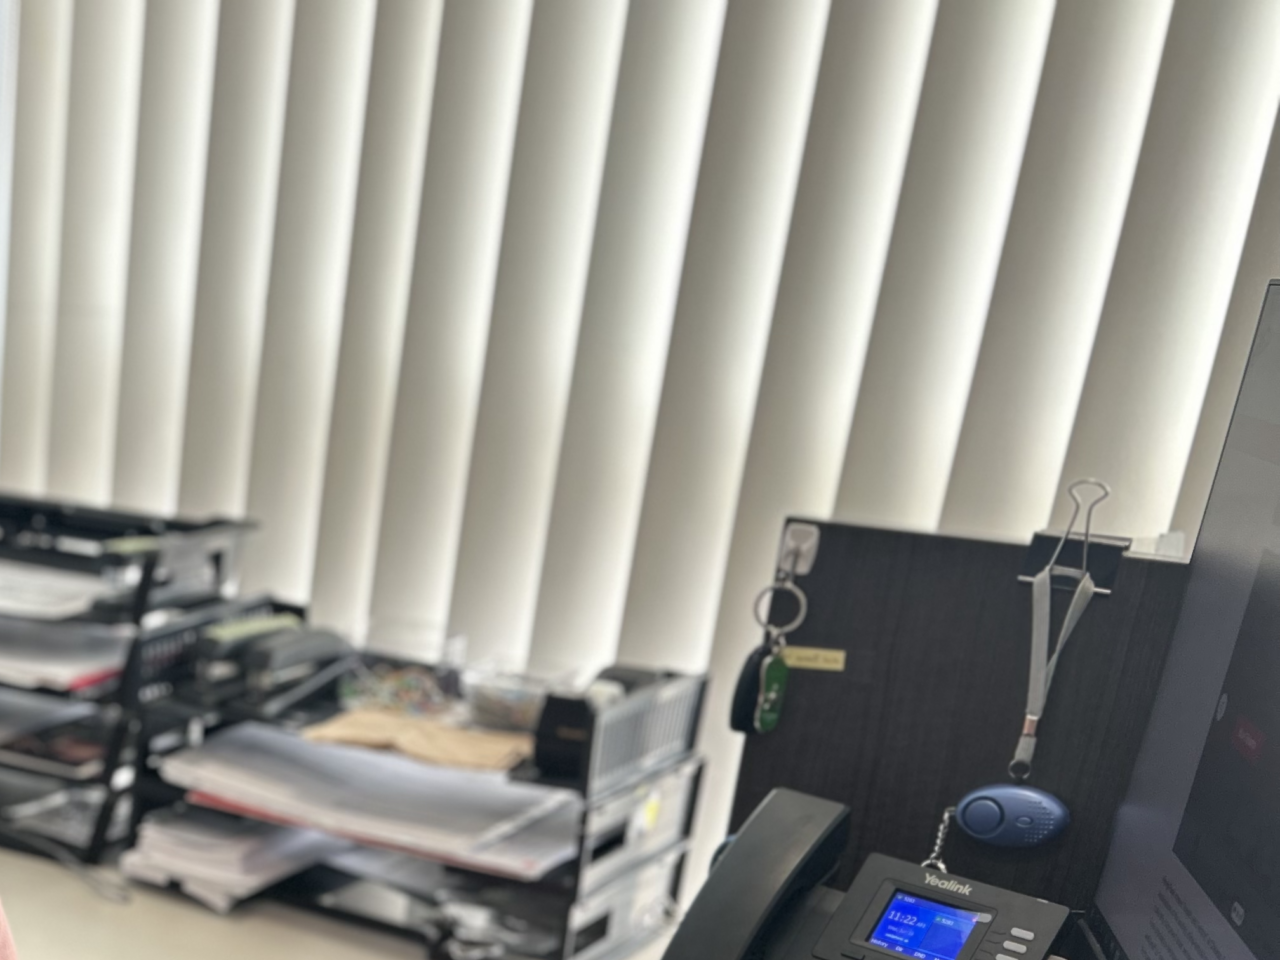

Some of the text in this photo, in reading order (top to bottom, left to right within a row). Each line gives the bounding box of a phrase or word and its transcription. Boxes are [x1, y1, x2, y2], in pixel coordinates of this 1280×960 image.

[925, 873, 973, 896] Yealink
[888, 911, 917, 925] 11:22
[871, 938, 888, 948] History
